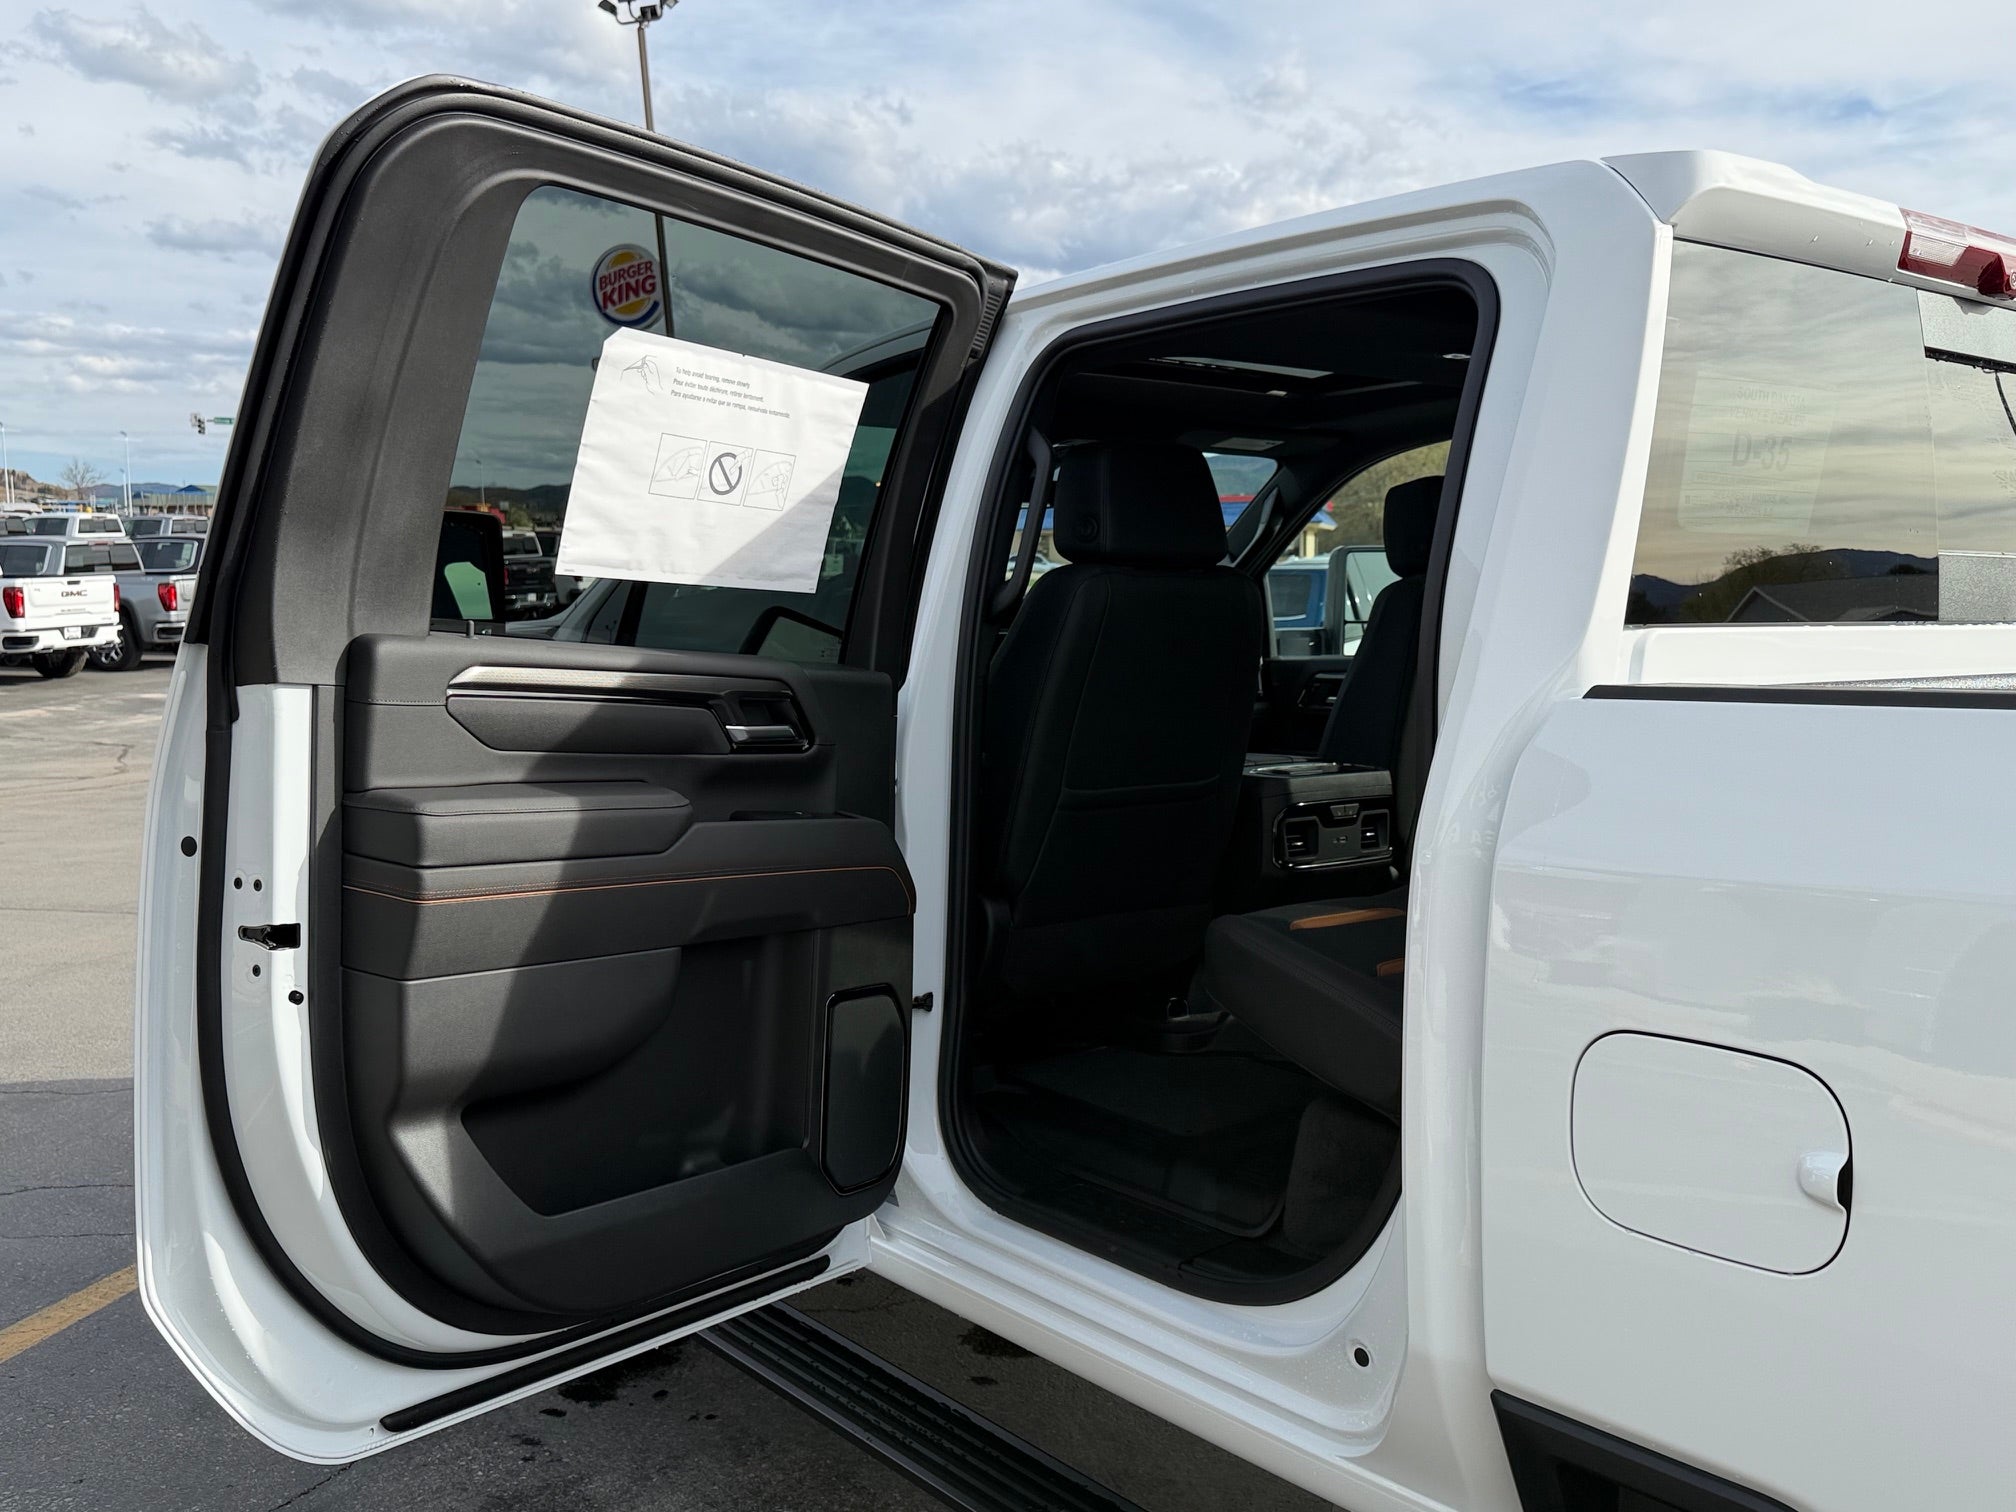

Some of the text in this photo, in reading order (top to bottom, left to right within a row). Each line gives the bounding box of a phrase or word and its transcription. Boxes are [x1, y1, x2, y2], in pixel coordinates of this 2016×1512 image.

[599, 260, 653, 291] BURGER
[602, 275, 656, 309] KING
[1736, 386, 1770, 401] SOUTH
[1732, 431, 1792, 472] D-35
[61, 589, 88, 598] GMC
